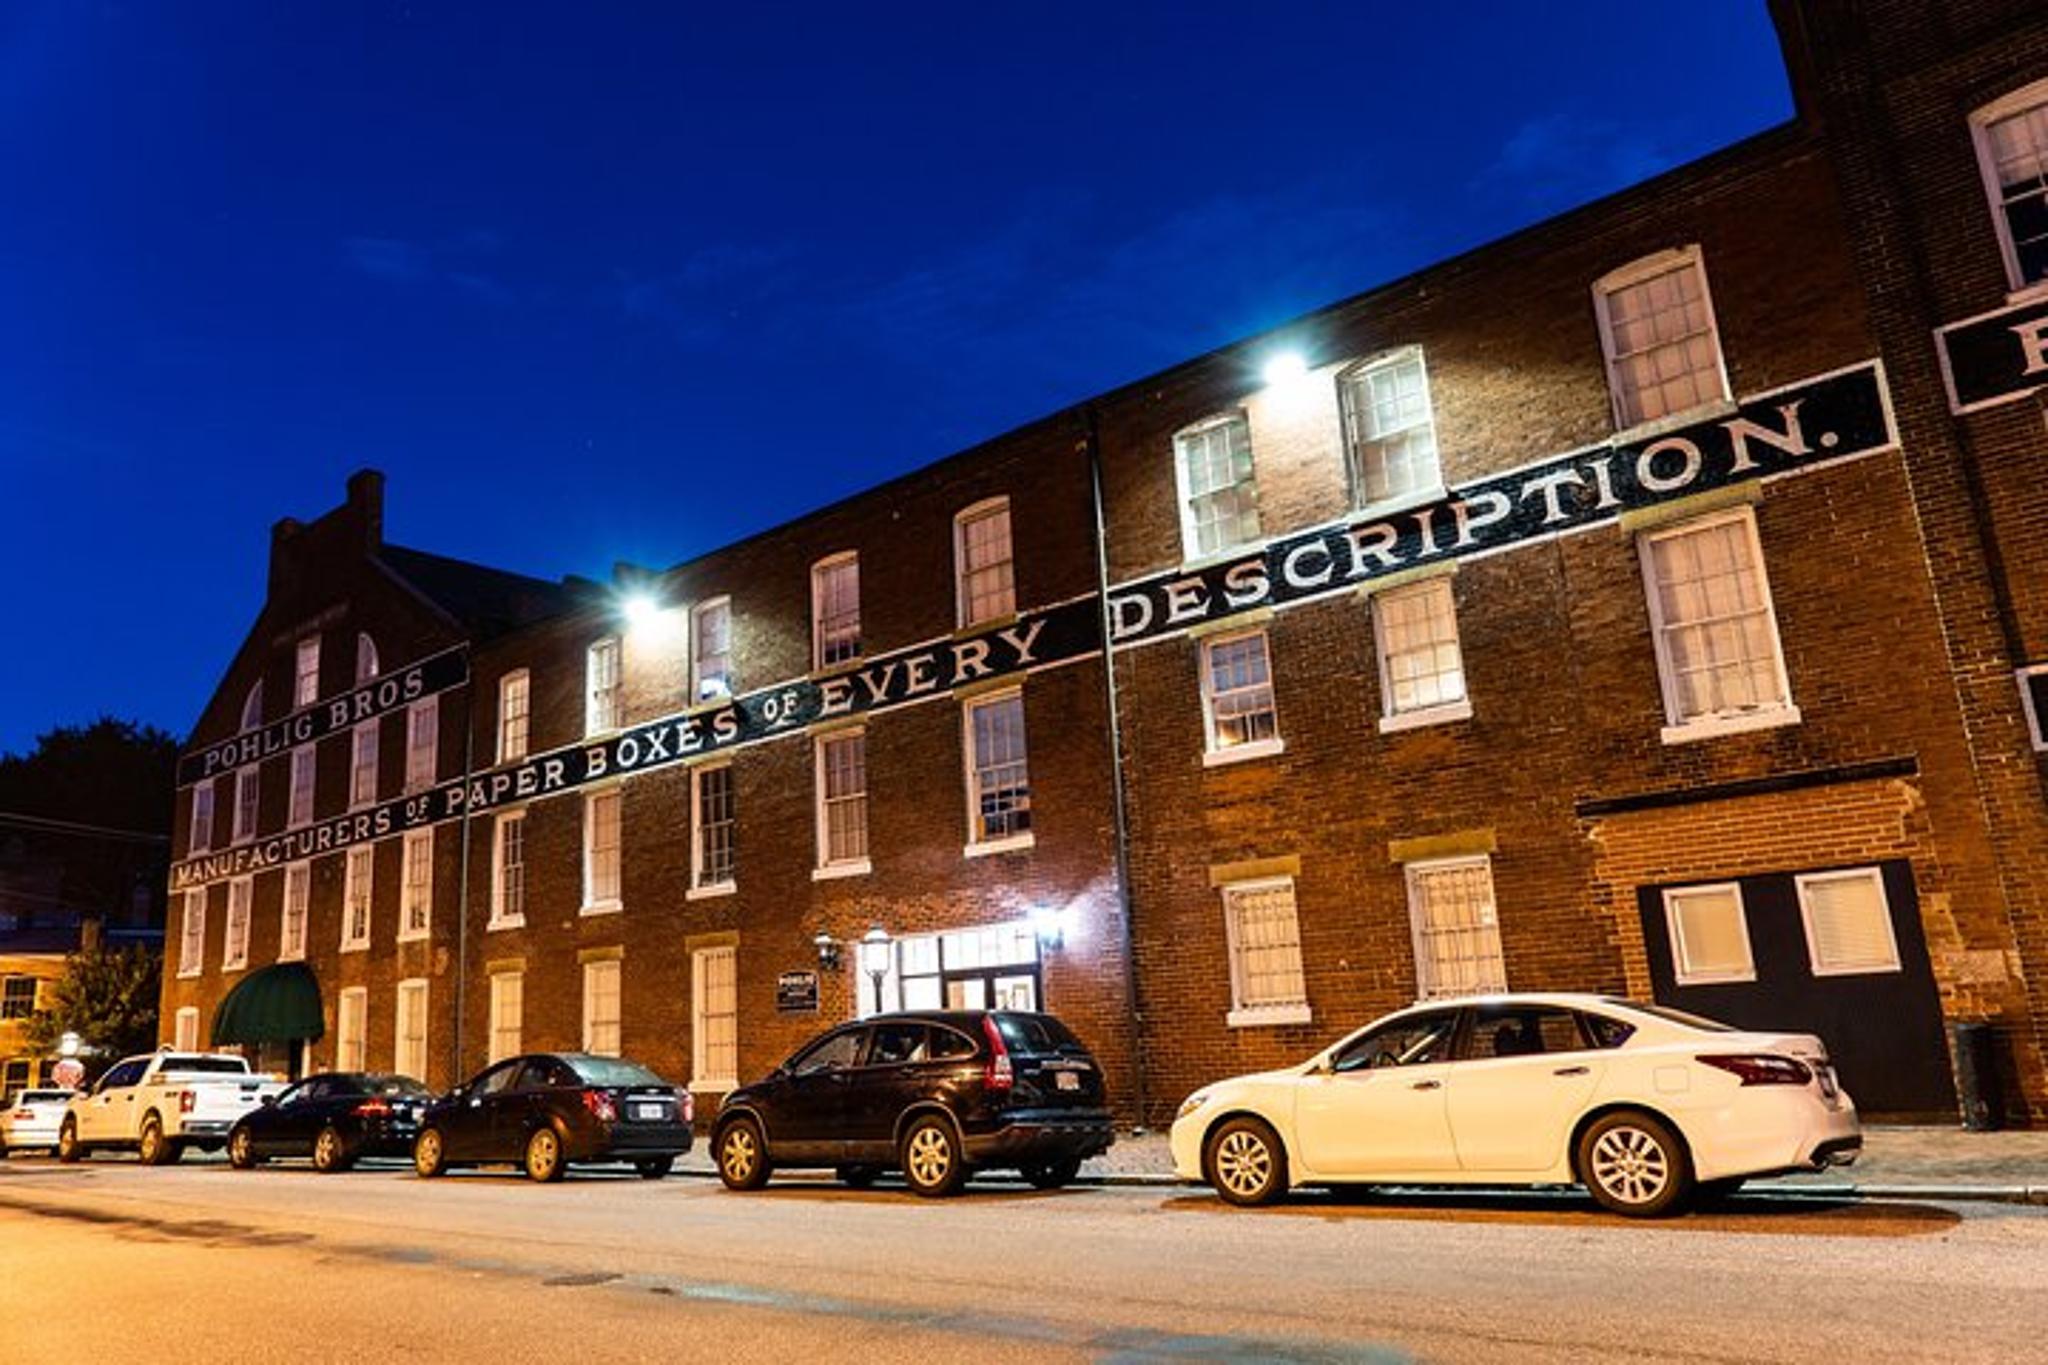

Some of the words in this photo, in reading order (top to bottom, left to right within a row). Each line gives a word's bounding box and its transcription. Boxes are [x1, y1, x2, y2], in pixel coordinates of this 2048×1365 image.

[177, 808, 391, 887] MANUFACTURERS
[405, 796, 430, 823] OF
[446, 760, 565, 815] PAPER
[585, 708, 739, 779] BOXES
[763, 689, 798, 727] OF
[817, 619, 1048, 719] EVERY
[1107, 399, 1840, 639] DESCRIPTION.
[204, 714, 312, 775] POHLIG
[329, 667, 424, 730] BROS
